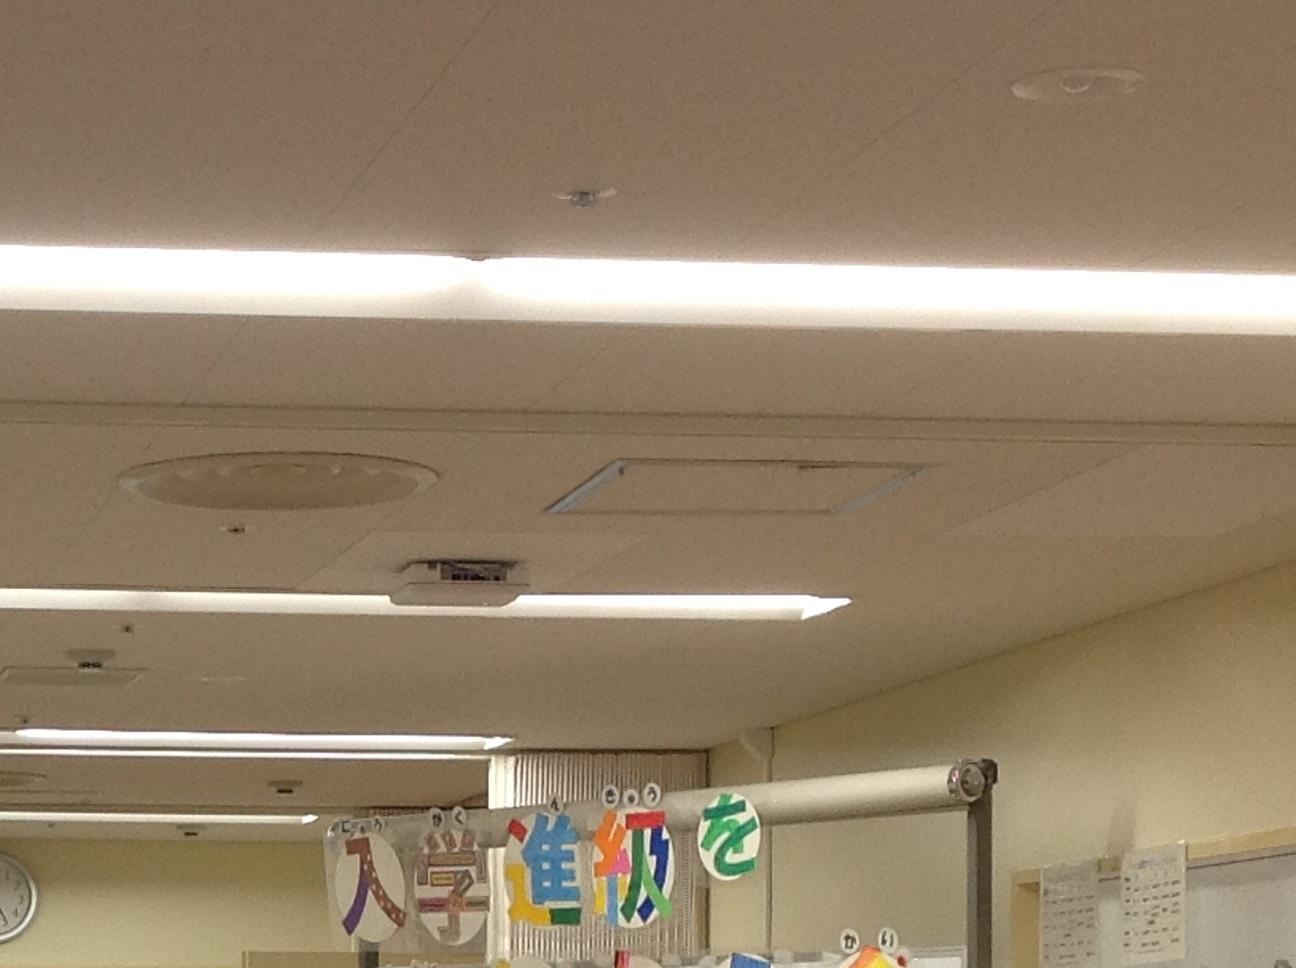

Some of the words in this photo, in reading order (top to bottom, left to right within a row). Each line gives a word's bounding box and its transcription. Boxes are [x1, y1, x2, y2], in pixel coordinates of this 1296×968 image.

[342, 793, 759, 940] 入学進級を
